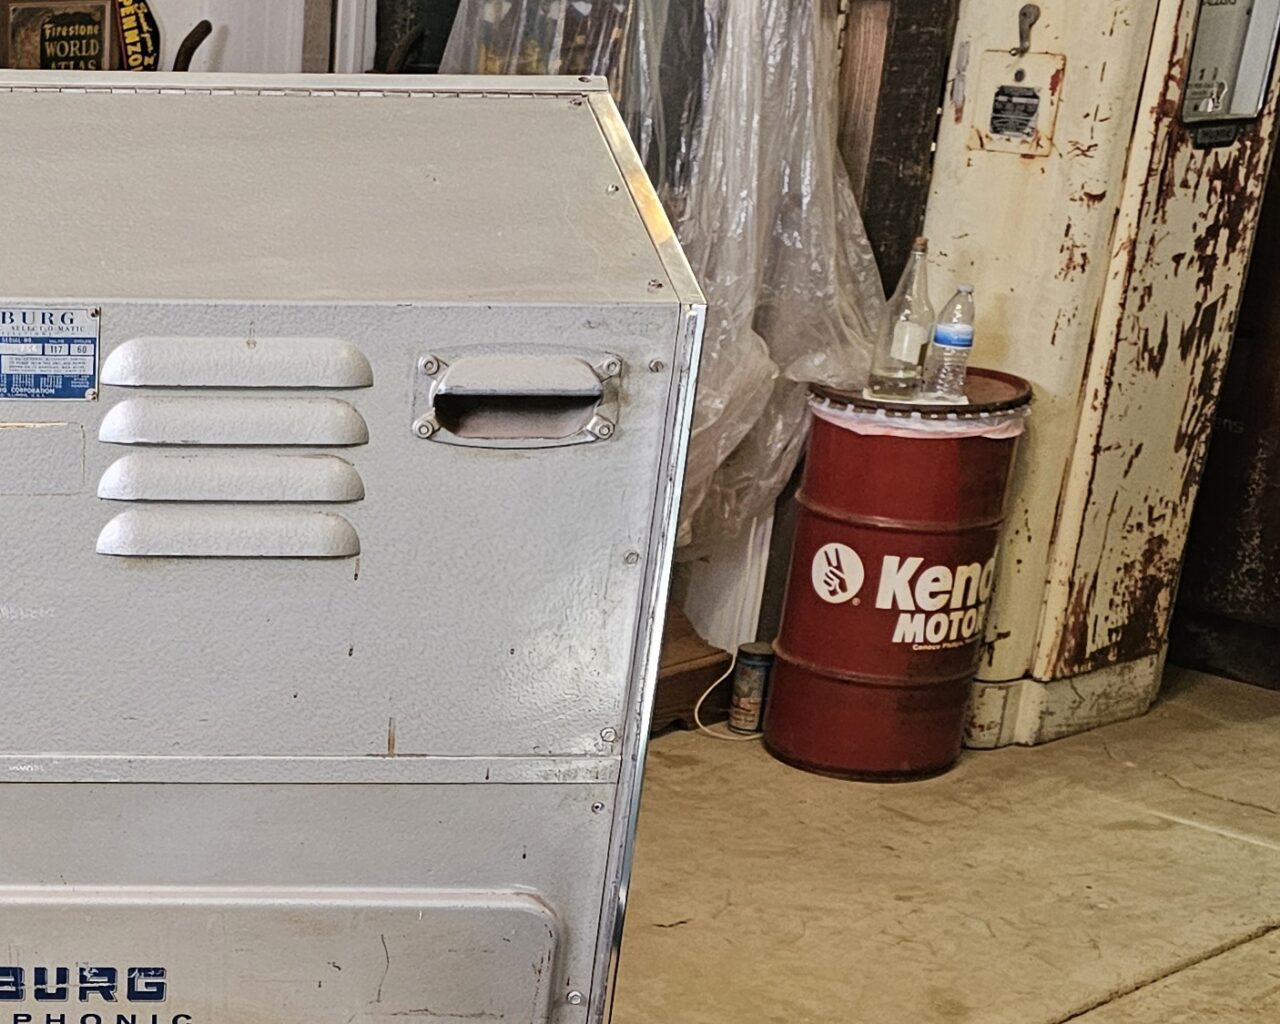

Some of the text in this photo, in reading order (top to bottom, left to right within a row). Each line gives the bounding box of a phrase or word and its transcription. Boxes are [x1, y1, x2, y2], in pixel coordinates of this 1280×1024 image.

[43, 23, 100, 40] Firestone
[44, 39, 100, 58] WORLD
[50, 345, 63, 354] 117
[77, 345, 88, 354] 60
[11, 386, 55, 395] CORPORATION
